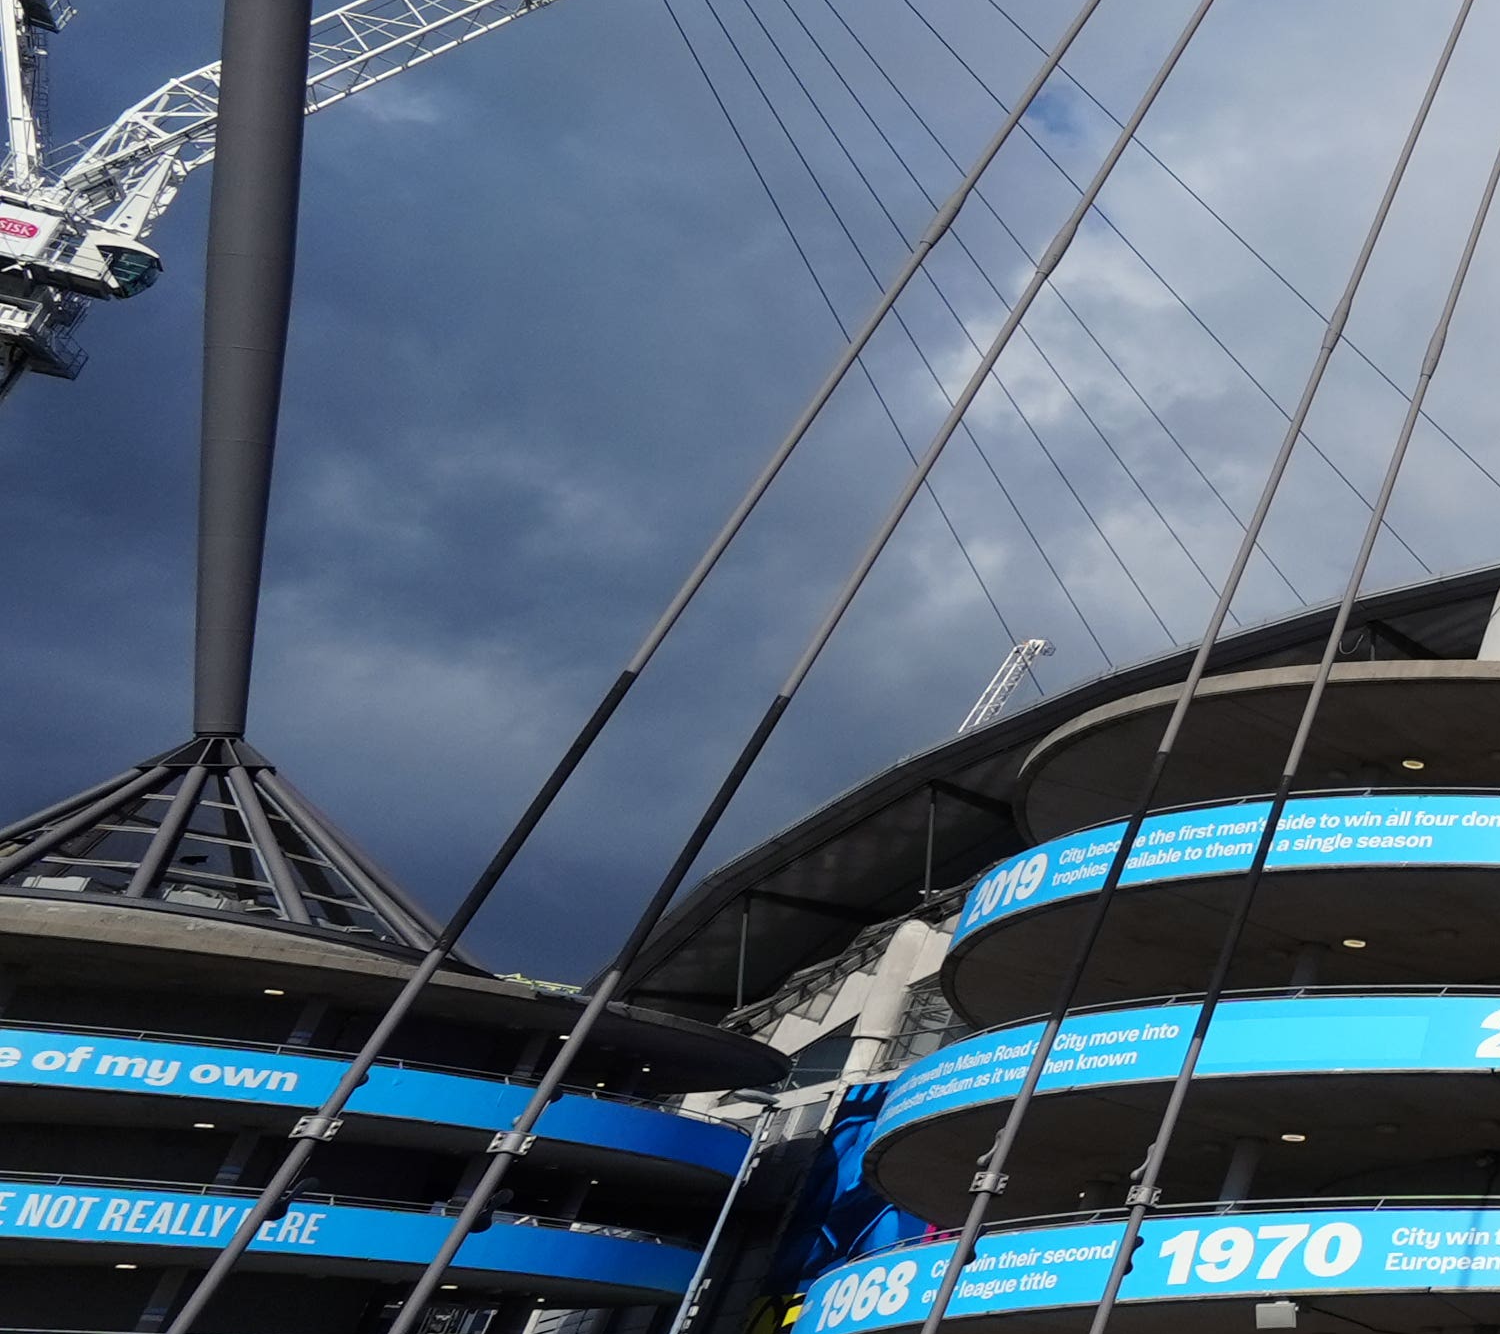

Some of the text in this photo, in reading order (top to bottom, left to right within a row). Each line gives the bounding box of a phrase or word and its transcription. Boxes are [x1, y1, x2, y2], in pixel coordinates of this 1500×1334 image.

[965, 853, 1048, 927] 2019
[1149, 828, 1175, 846] the
[1178, 822, 1214, 842] first
[1320, 813, 1341, 828] to
[1344, 811, 1383, 827] win
[1385, 810, 1409, 826] all
[1414, 810, 1459, 827] four
[1052, 862, 1108, 886] trophies
[1184, 845, 1202, 861] to
[1292, 833, 1353, 853] single
[1356, 834, 1433, 849] season
[1053, 1023, 1180, 1052] City move into
[1076, 1050, 1137, 1070] known
[32, 1047, 95, 1072] of
[95, 1054, 181, 1086] my
[190, 1064, 298, 1091] own
[16, 1193, 105, 1229] NOT
[97, 1198, 236, 1238] REALLY
[1158, 1222, 1363, 1285] 1970
[1392, 1227, 1442, 1248] City
[1445, 1228, 1491, 1246] win
[815, 1259, 919, 1333] 1968
[999, 1248, 1041, 1268] their
[1043, 1240, 1118, 1264] second
[959, 1278, 1017, 1299] league
[1019, 1271, 1058, 1290] title
